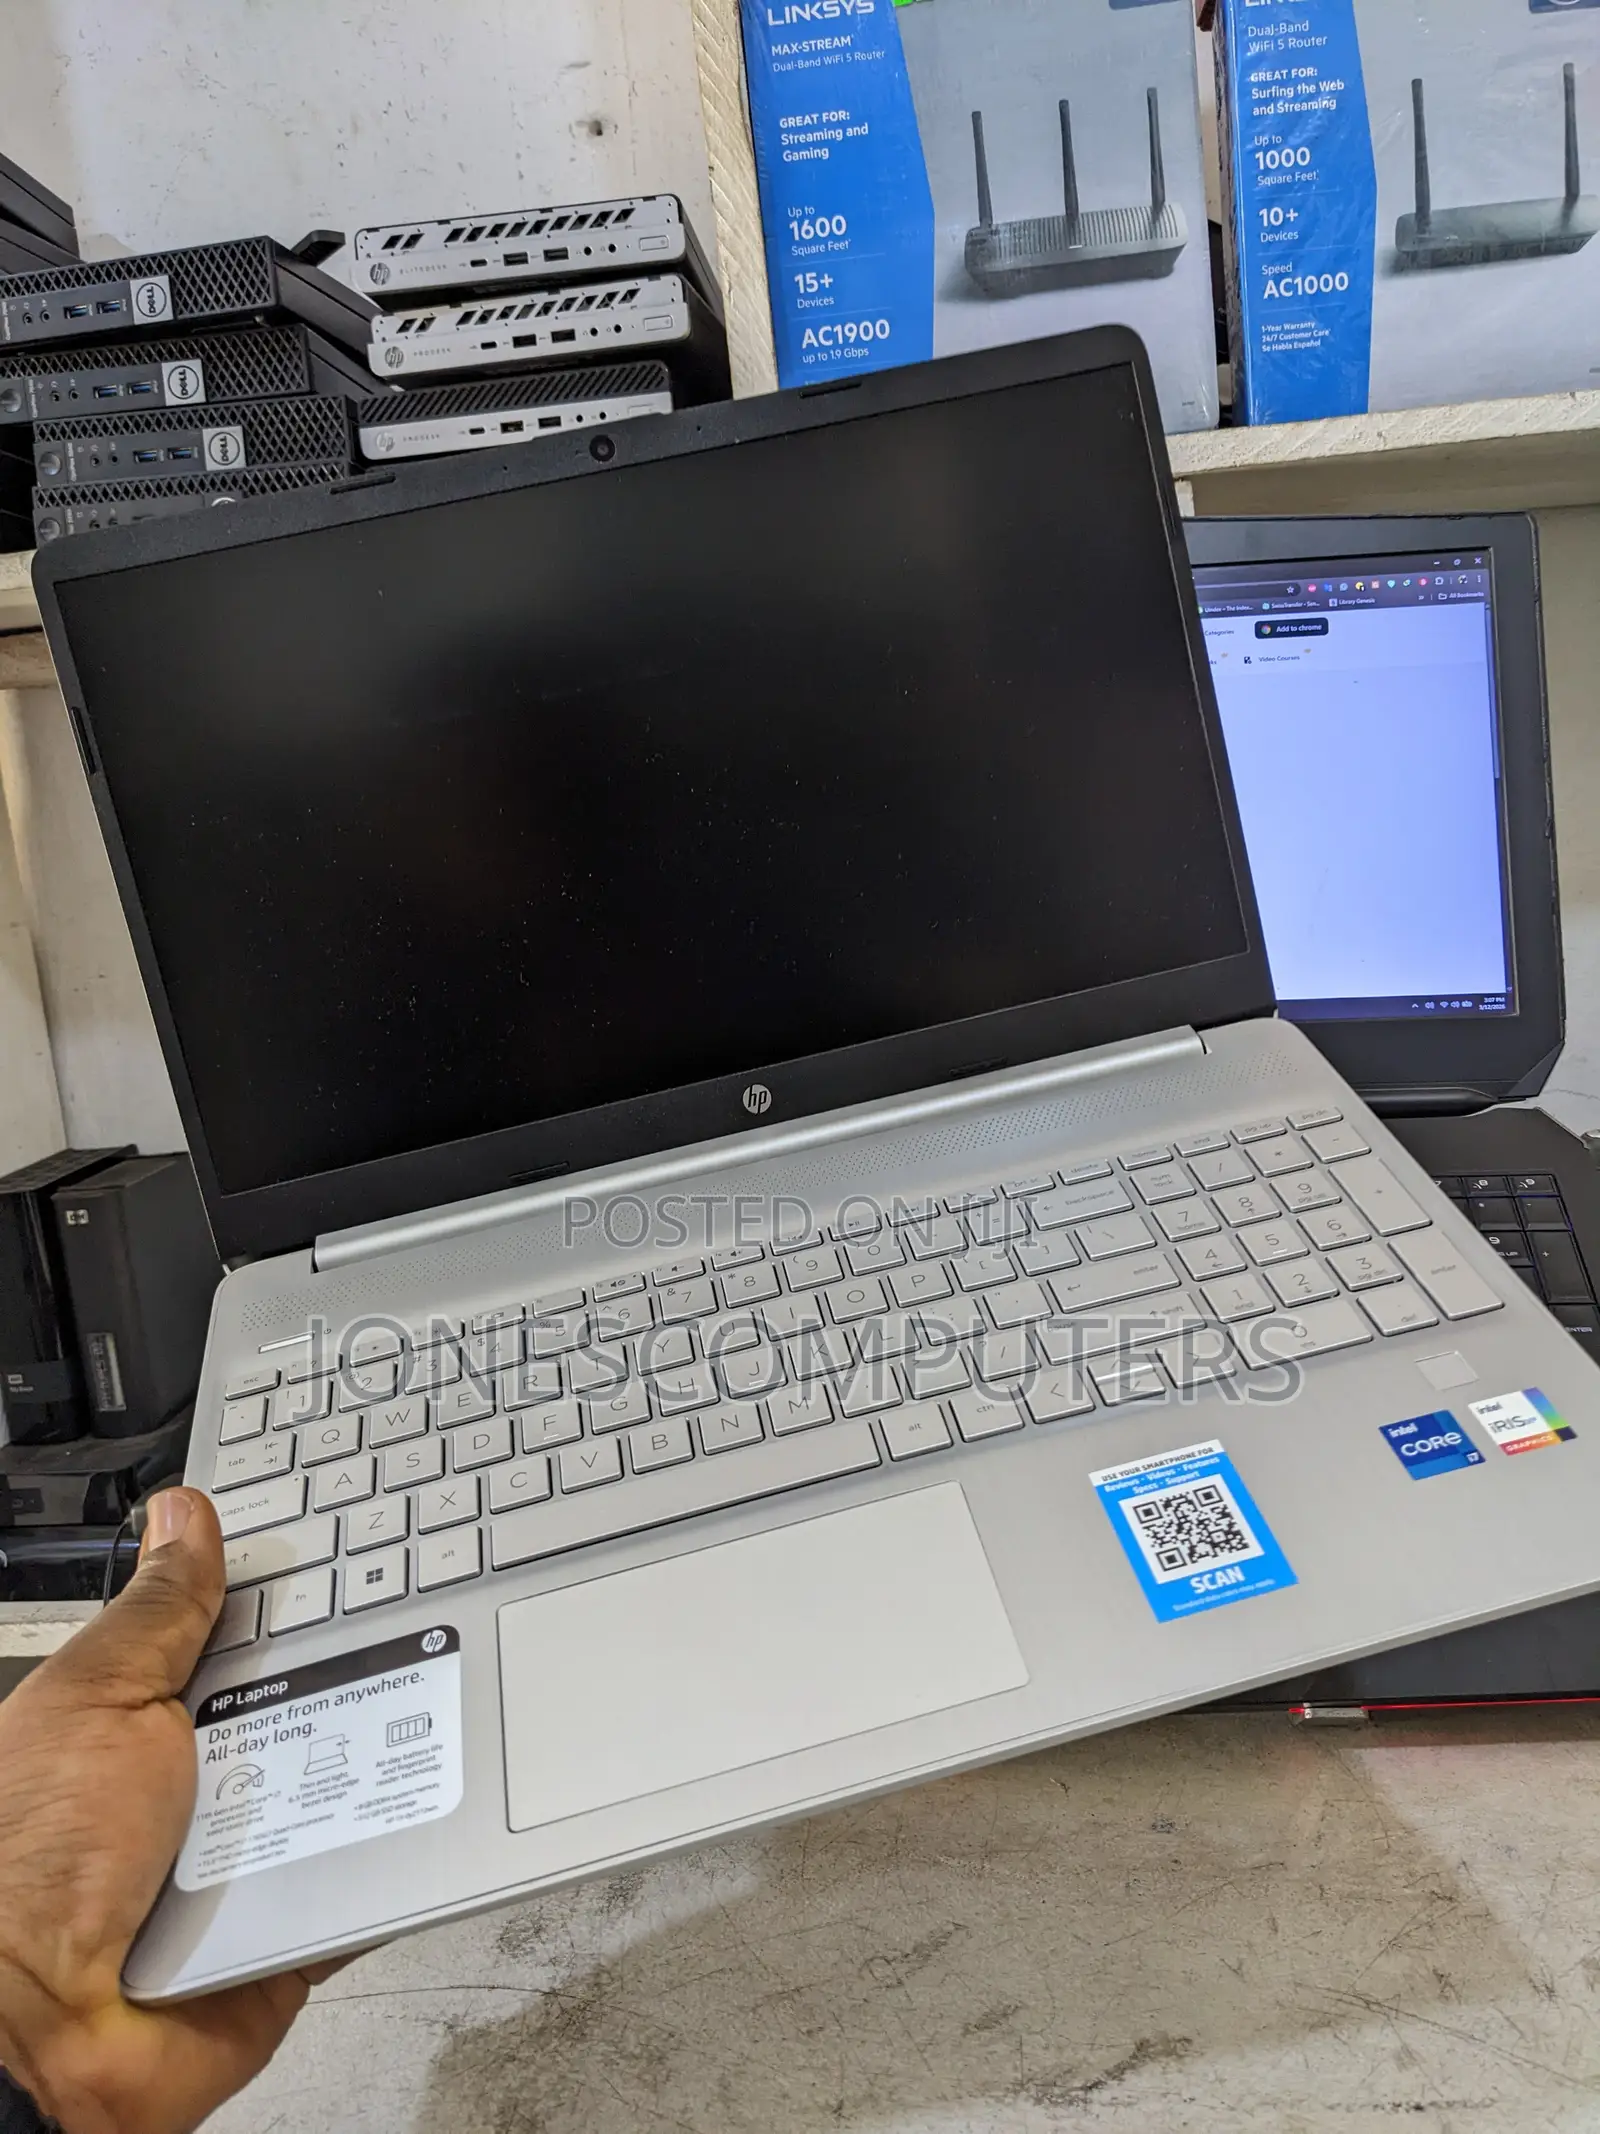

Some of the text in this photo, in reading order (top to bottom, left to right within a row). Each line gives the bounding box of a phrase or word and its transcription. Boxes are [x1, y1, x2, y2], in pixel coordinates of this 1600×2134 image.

[767, 0, 875, 26] LINKSYS
[1248, 20, 1310, 37] Dual-Band
[1249, 35, 1328, 53] WiFi 5 Router
[773, 50, 885, 72] Dual-Band WiFi 5 Router
[1250, 67, 1318, 83] GREAT FOR:
[1251, 79, 1345, 100] Surfing the Web
[1253, 97, 1337, 116] and Streaming
[779, 110, 850, 129] GREAT FOR:
[781, 122, 869, 146] Streaming and
[1254, 134, 1282, 147] Up to
[783, 147, 829, 163] Gaming
[1255, 146, 1310, 171] 1000
[1258, 174, 1292, 188] Square
[787, 205, 815, 218] Up to
[1259, 207, 1298, 227] 10+
[789, 215, 847, 241] 1600
[1260, 230, 1299, 243] Devices
[791, 243, 826, 257] Square
[370, 262, 390, 285] hp
[1261, 262, 1293, 276] Speed
[794, 272, 834, 294] 15+
[1263, 272, 1349, 300] AC1000
[797, 296, 835, 309] Devices
[802, 319, 890, 349] AC1900
[1261, 321, 1316, 333] 1-Year Warranty
[1261, 334, 1278, 343] 24/7
[1278, 331, 1312, 341] Customer
[803, 355, 815, 364] up
[818, 352, 828, 361] to
[844, 347, 869, 359] Gbps
[1261, 344, 1271, 353] Se
[1272, 341, 1293, 352] Habla
[385, 346, 404, 368] hp
[1204, 629, 1234, 638] Categories
[1276, 625, 1289, 633] Add
[1277, 654, 1300, 662] Courses
[742, 1084, 772, 1115] hp
[1133, 1265, 1158, 1275] enter
[243, 1376, 259, 1384] esc
[976, 1403, 994, 1413] ctrl
[1476, 1402, 1503, 1415] intel
[385, 1408, 411, 1427] W
[721, 1415, 739, 1431] N
[908, 1422, 922, 1432] alt
[1388, 1423, 1418, 1438] intel
[321, 1429, 340, 1443] Q
[473, 1435, 490, 1450] D
[652, 1434, 668, 1451] B
[228, 1458, 245, 1466] tab
[406, 1452, 420, 1468] S
[580, 1452, 597, 1469] V
[1101, 1447, 1214, 1482] USE YOUR SMARTPHONE FOR
[334, 1473, 353, 1489] A
[510, 1473, 527, 1488] C
[1104, 1457, 1220, 1493] Reviews Videos Features
[1133, 1471, 1200, 1495] Specs Support
[221, 1498, 269, 1517] caps lock
[439, 1492, 456, 1510] X
[368, 1512, 384, 1529] Z
[442, 1550, 454, 1559] alt
[1190, 1566, 1246, 1594] SCAN
[421, 1629, 447, 1653] hp
[211, 1680, 289, 1713] HP Laptop
[207, 1671, 425, 1746] Do more from anywhere.
[205, 1721, 317, 1765] All-day long.
[376, 1744, 443, 1769] All-day battery life
[376, 1763, 443, 1787] reader technology
[382, 1767, 396, 1776] and
[317, 1778, 329, 1786] and
[323, 1791, 348, 1803] design
